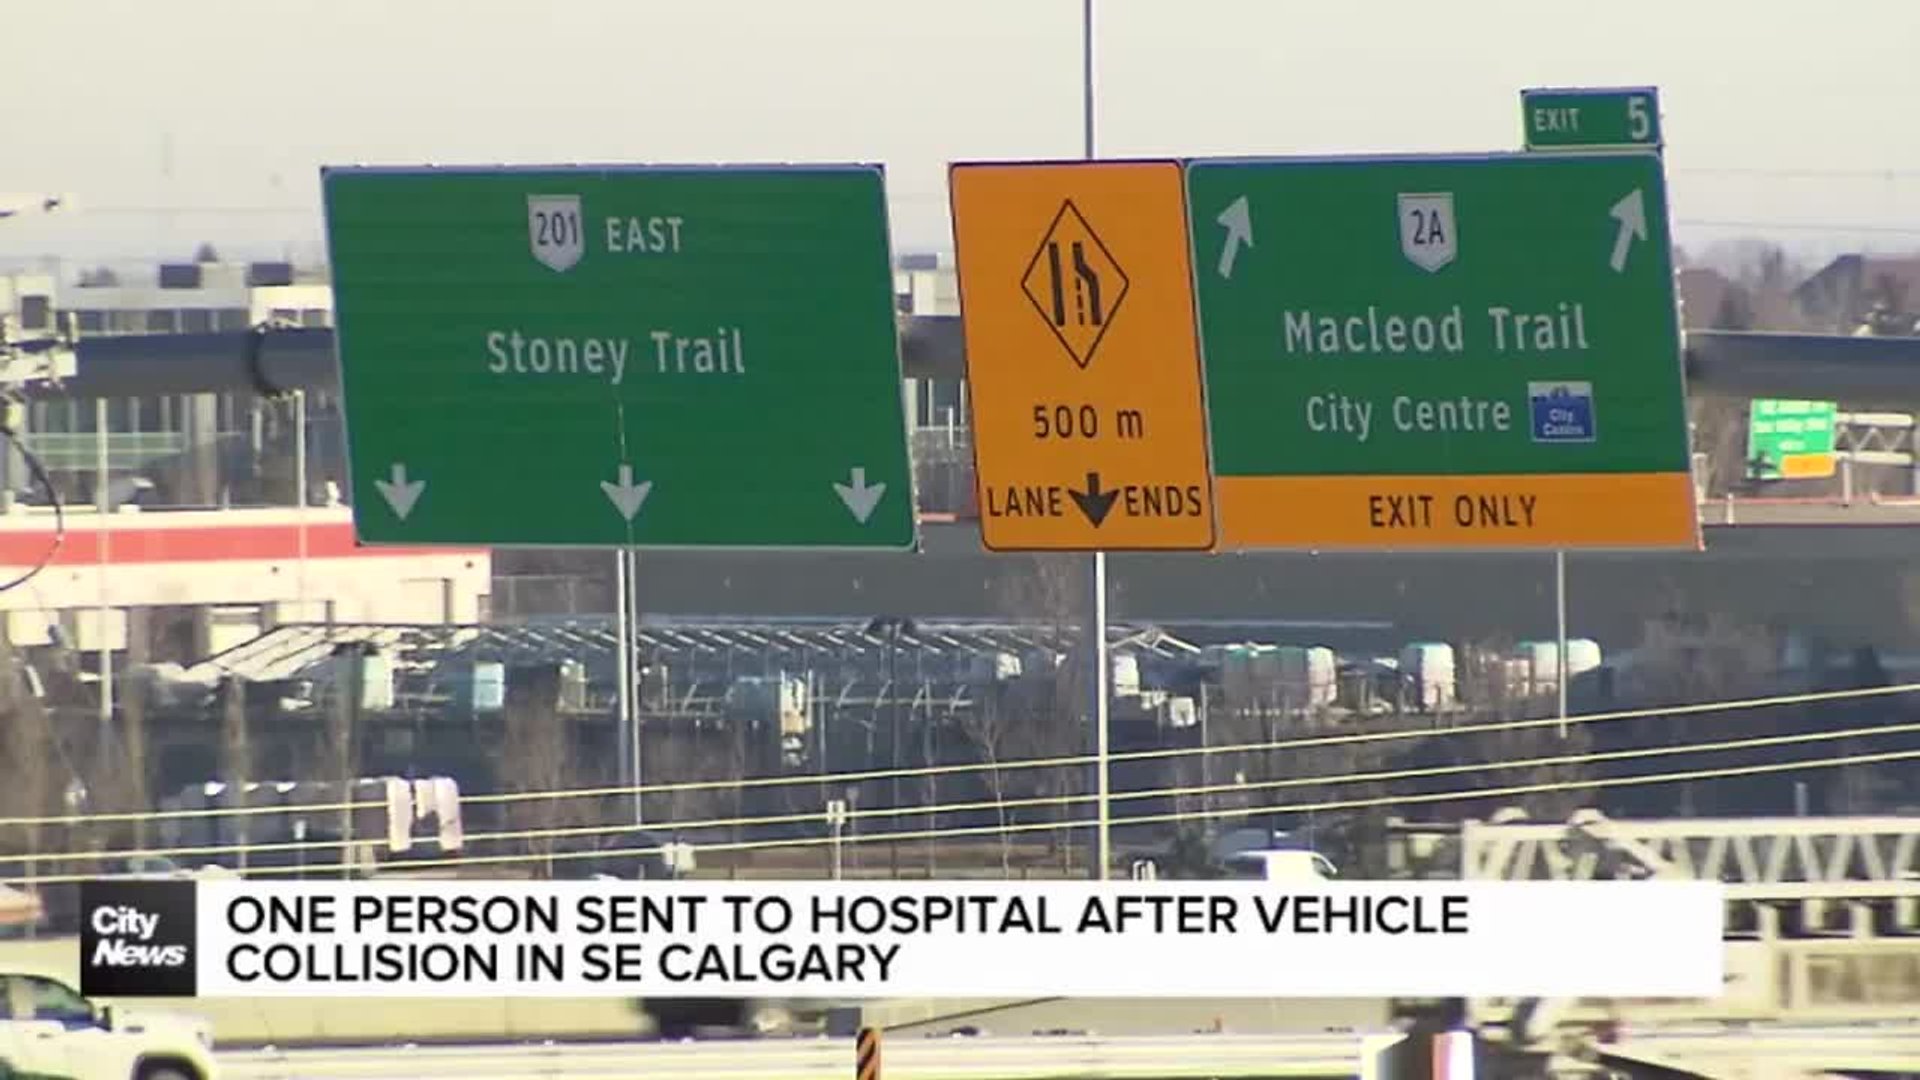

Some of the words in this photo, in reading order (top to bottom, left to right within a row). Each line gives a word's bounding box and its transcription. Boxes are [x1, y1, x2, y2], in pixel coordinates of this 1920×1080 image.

[1534, 107, 1580, 132] EXIT
[1628, 97, 1649, 140] 5
[535, 211, 578, 247] 201
[606, 217, 684, 253] EAST
[1411, 209, 1446, 245] 2A
[1283, 304, 1464, 353] Macleod
[1487, 302, 1589, 350] Trail
[487, 331, 629, 385] Stoney
[651, 328, 745, 374] Trail
[1033, 405, 1098, 439] 500
[1116, 409, 1144, 439] m
[1306, 393, 1373, 442] City
[1393, 394, 1511, 432] Centre
[987, 485, 1064, 517] LANE
[1125, 485, 1203, 517] ENDS
[1369, 495, 1434, 528] EXIT
[1455, 494, 1538, 527] ONLY
